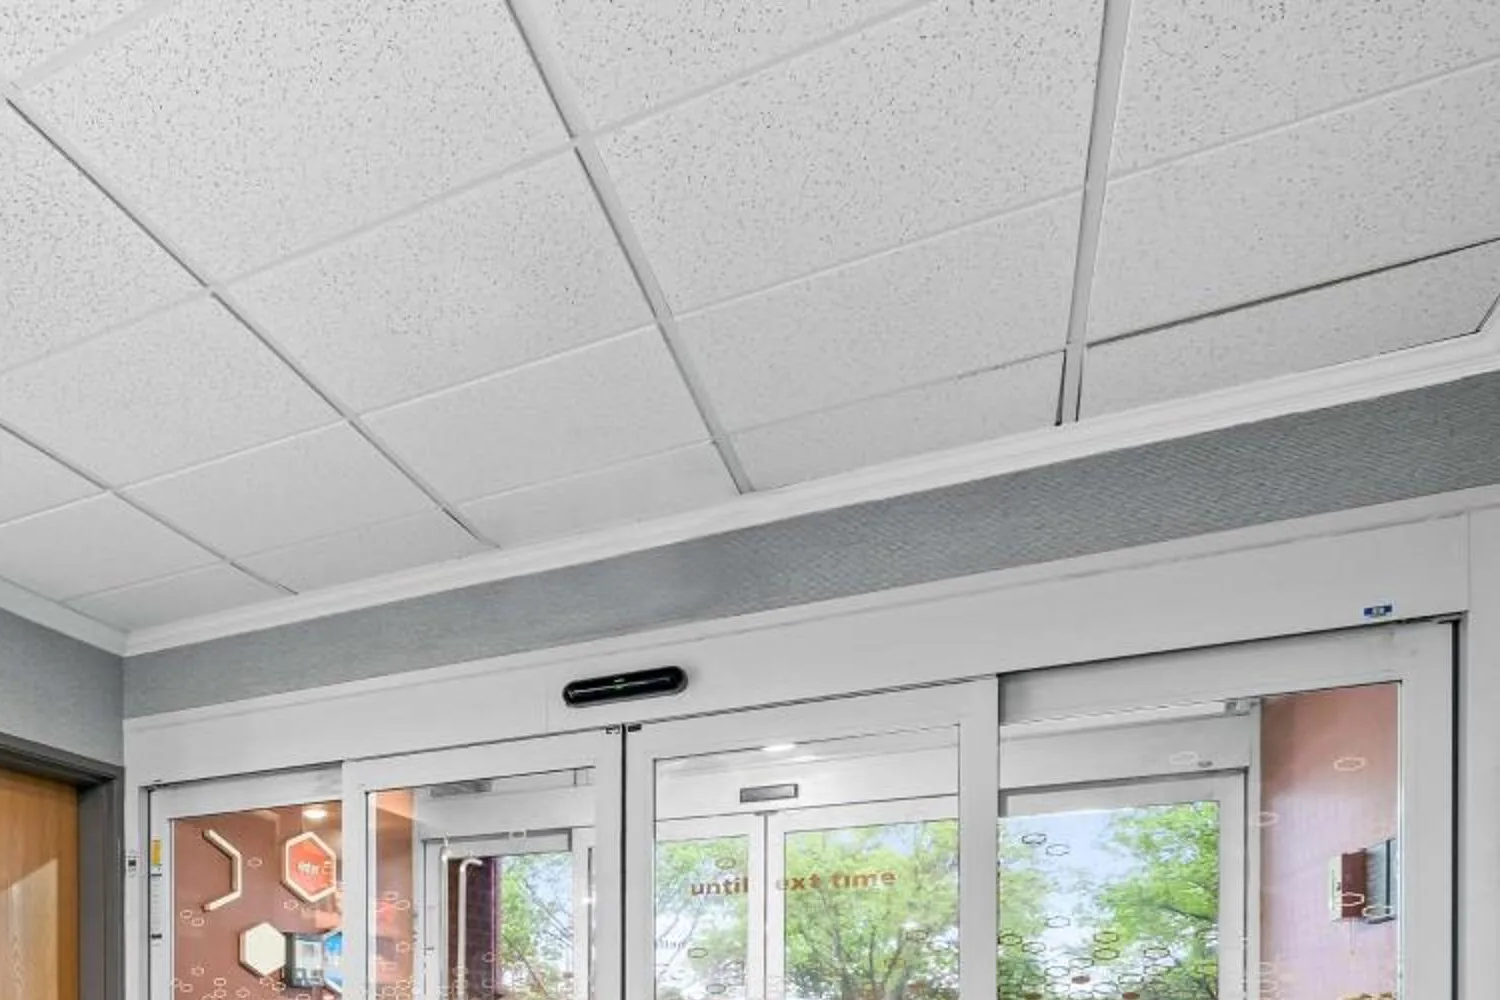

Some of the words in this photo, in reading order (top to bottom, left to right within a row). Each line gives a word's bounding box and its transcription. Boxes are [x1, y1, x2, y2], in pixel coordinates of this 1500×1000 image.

[691, 876, 749, 896] until
[775, 872, 822, 891] ext
[830, 870, 896, 889] time
